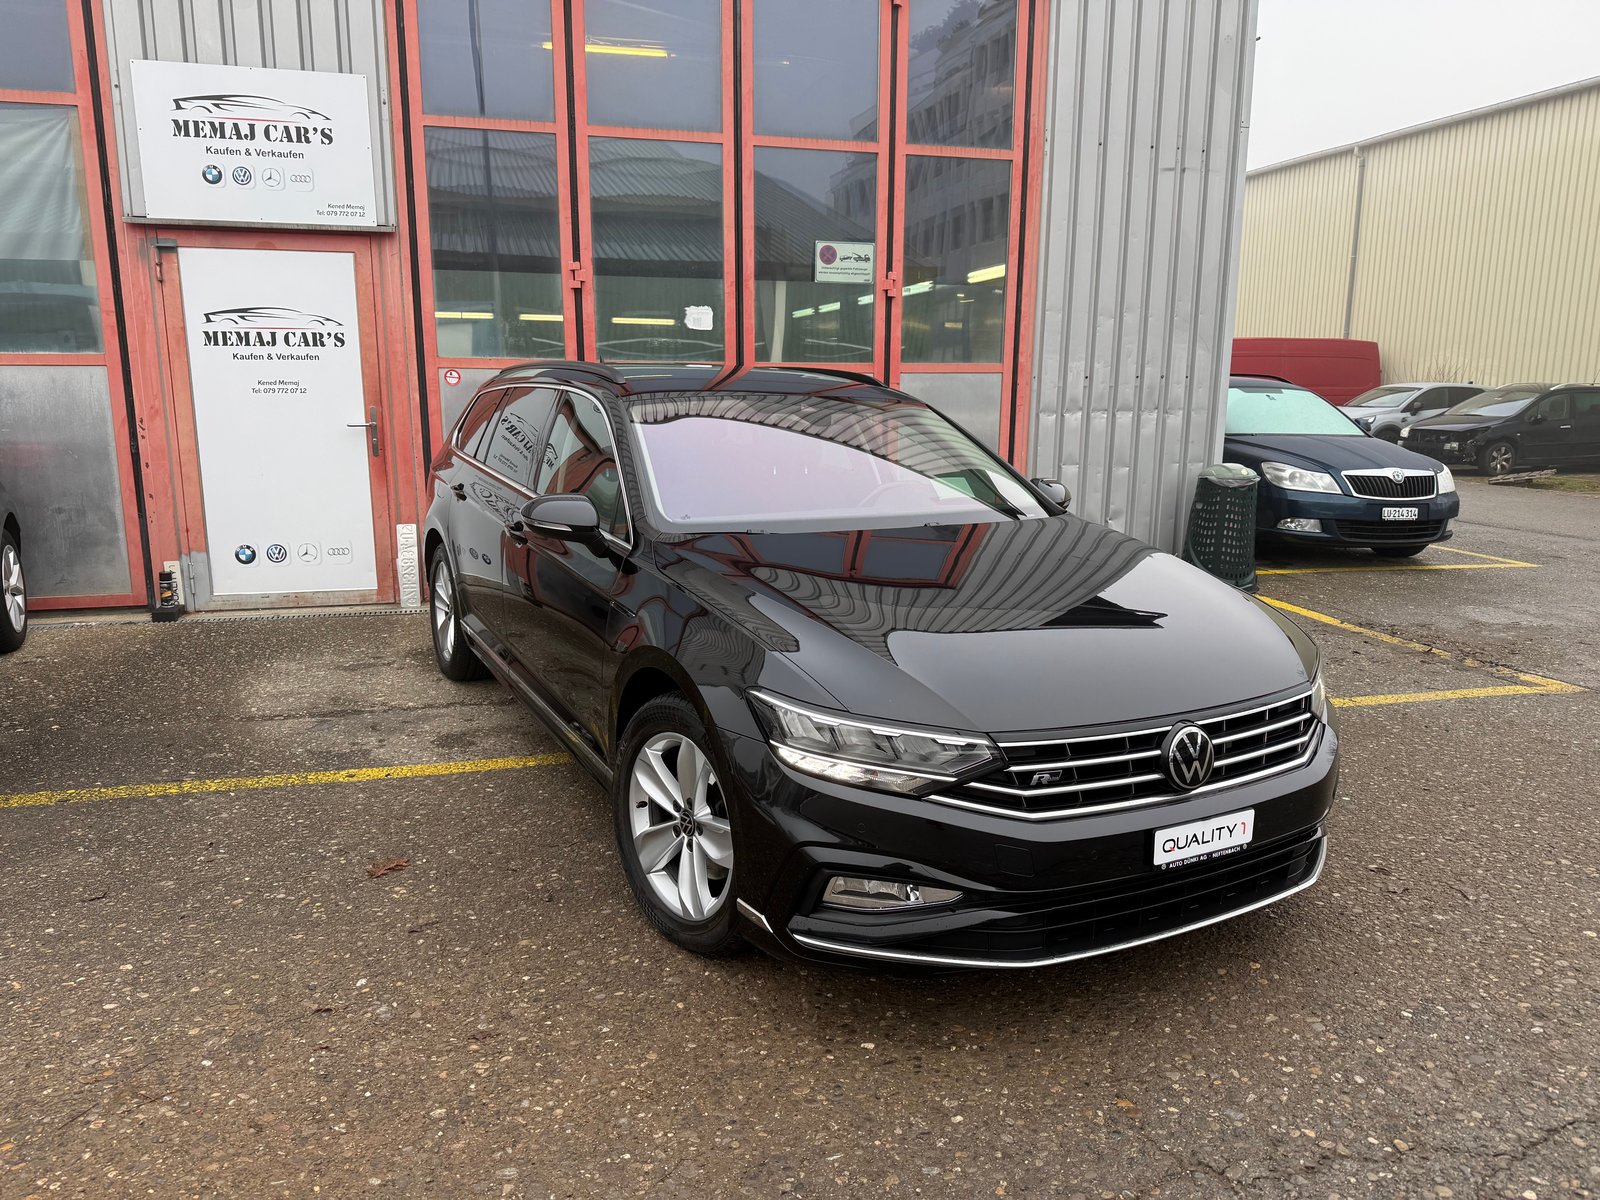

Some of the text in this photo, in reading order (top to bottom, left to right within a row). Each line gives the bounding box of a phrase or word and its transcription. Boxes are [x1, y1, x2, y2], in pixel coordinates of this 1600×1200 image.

[171, 119, 334, 146] MEMAJ CAR'S
[205, 145, 305, 159] Kaufen & Verkaufen
[202, 331, 346, 348] MEMAJ CAR'S
[232, 353, 320, 361] Kaufen & Verkaufen
[1168, 860, 1183, 869] AUTO
